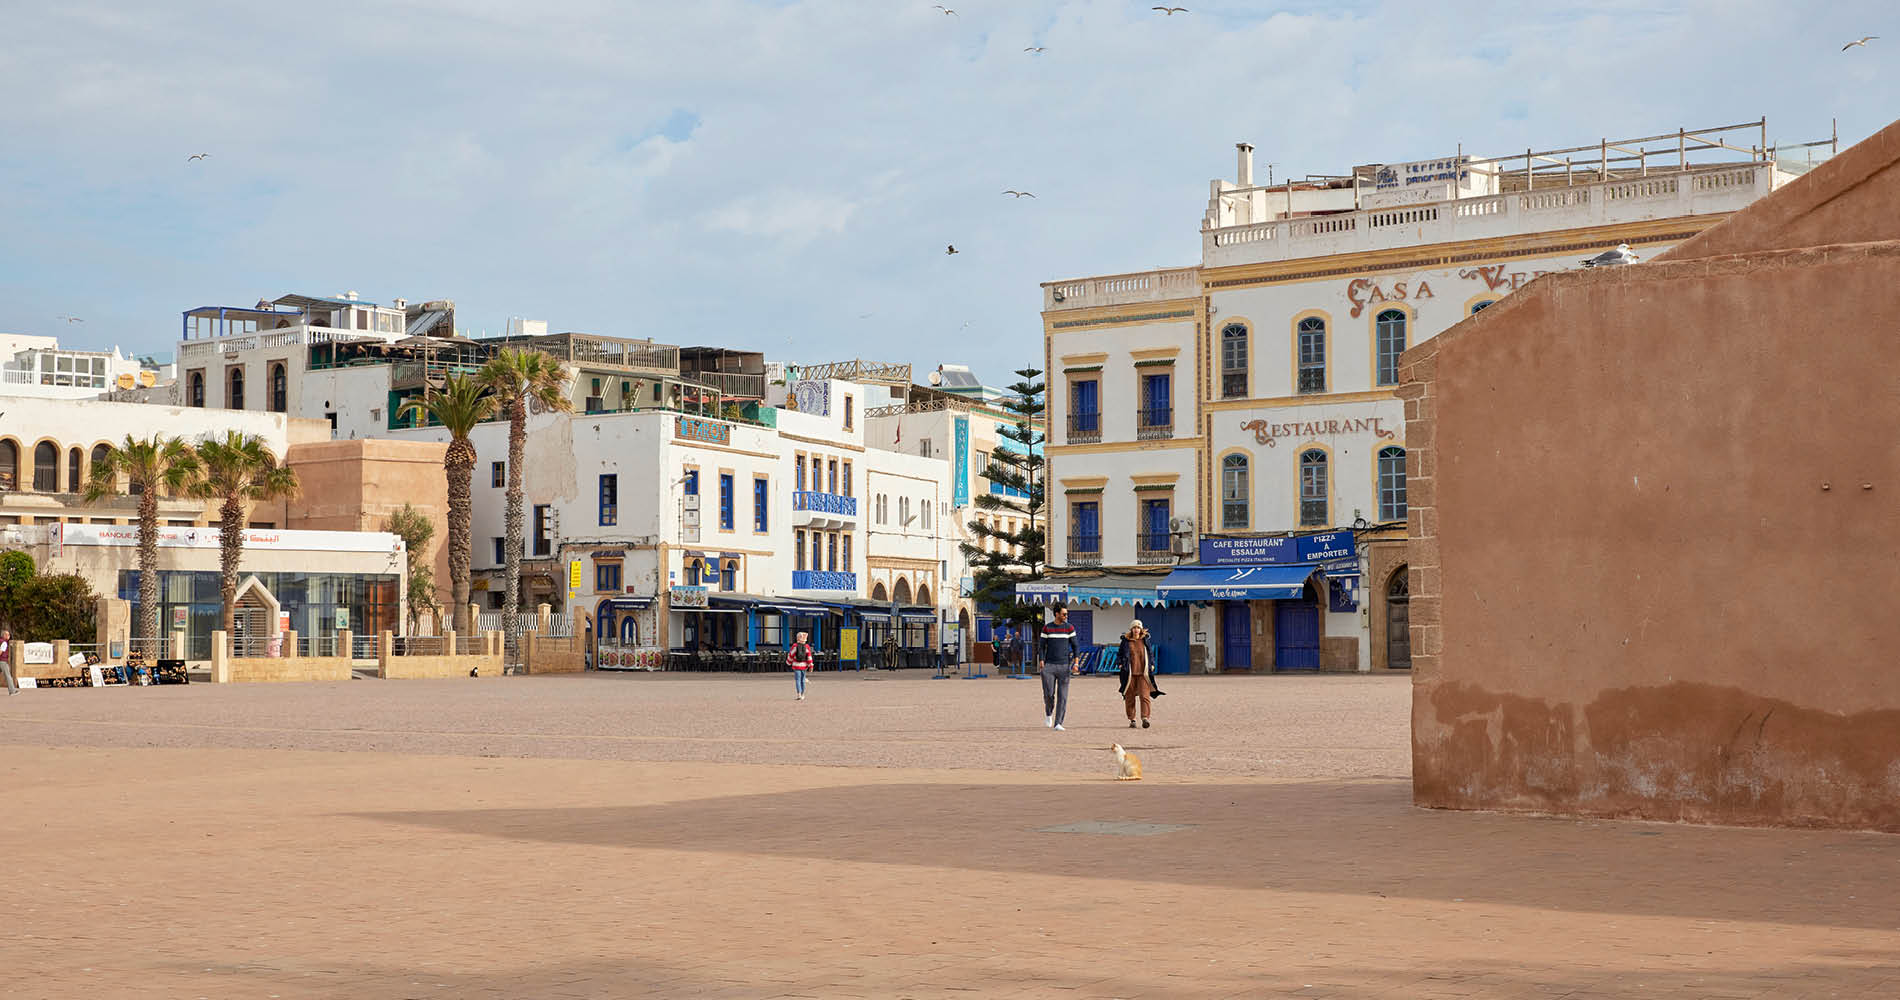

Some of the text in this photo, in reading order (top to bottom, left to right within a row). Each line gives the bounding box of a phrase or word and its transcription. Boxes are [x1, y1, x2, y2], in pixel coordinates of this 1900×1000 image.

[1347, 278, 1434, 319] CASA
[690, 420, 727, 442] TAROS
[1240, 418, 1395, 448] RESTAURANT
[1234, 538, 1284, 548] RESTAURANT
[1313, 535, 1336, 543] PIZZA
[1307, 549, 1348, 560] EMPORTER
